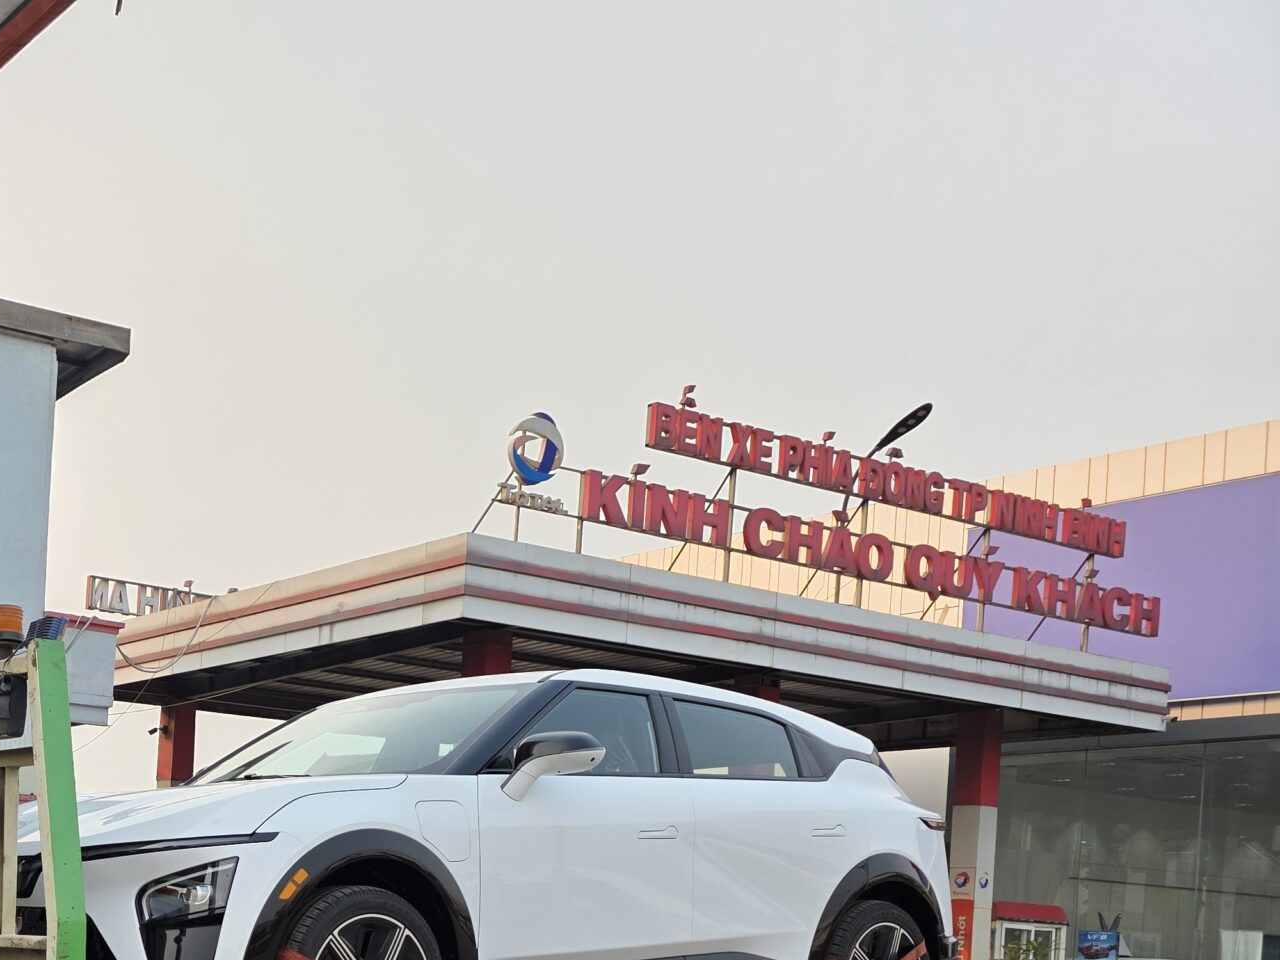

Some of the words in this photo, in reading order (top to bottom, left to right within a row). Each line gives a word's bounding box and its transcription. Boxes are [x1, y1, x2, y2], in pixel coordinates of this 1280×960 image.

[498, 482, 568, 514] TOTAL
[582, 463, 730, 547] KÍNH
[743, 509, 893, 582] CHÀO
[904, 544, 1005, 602] QUÝ
[1011, 569, 1161, 638] KHÁCH
[645, 384, 723, 461] BẾN
[728, 421, 774, 470] XE
[778, 431, 854, 493] PHÍA
[948, 478, 988, 522] TP
[989, 489, 1060, 542] NINH
[1062, 497, 1127, 558] BÌNH
